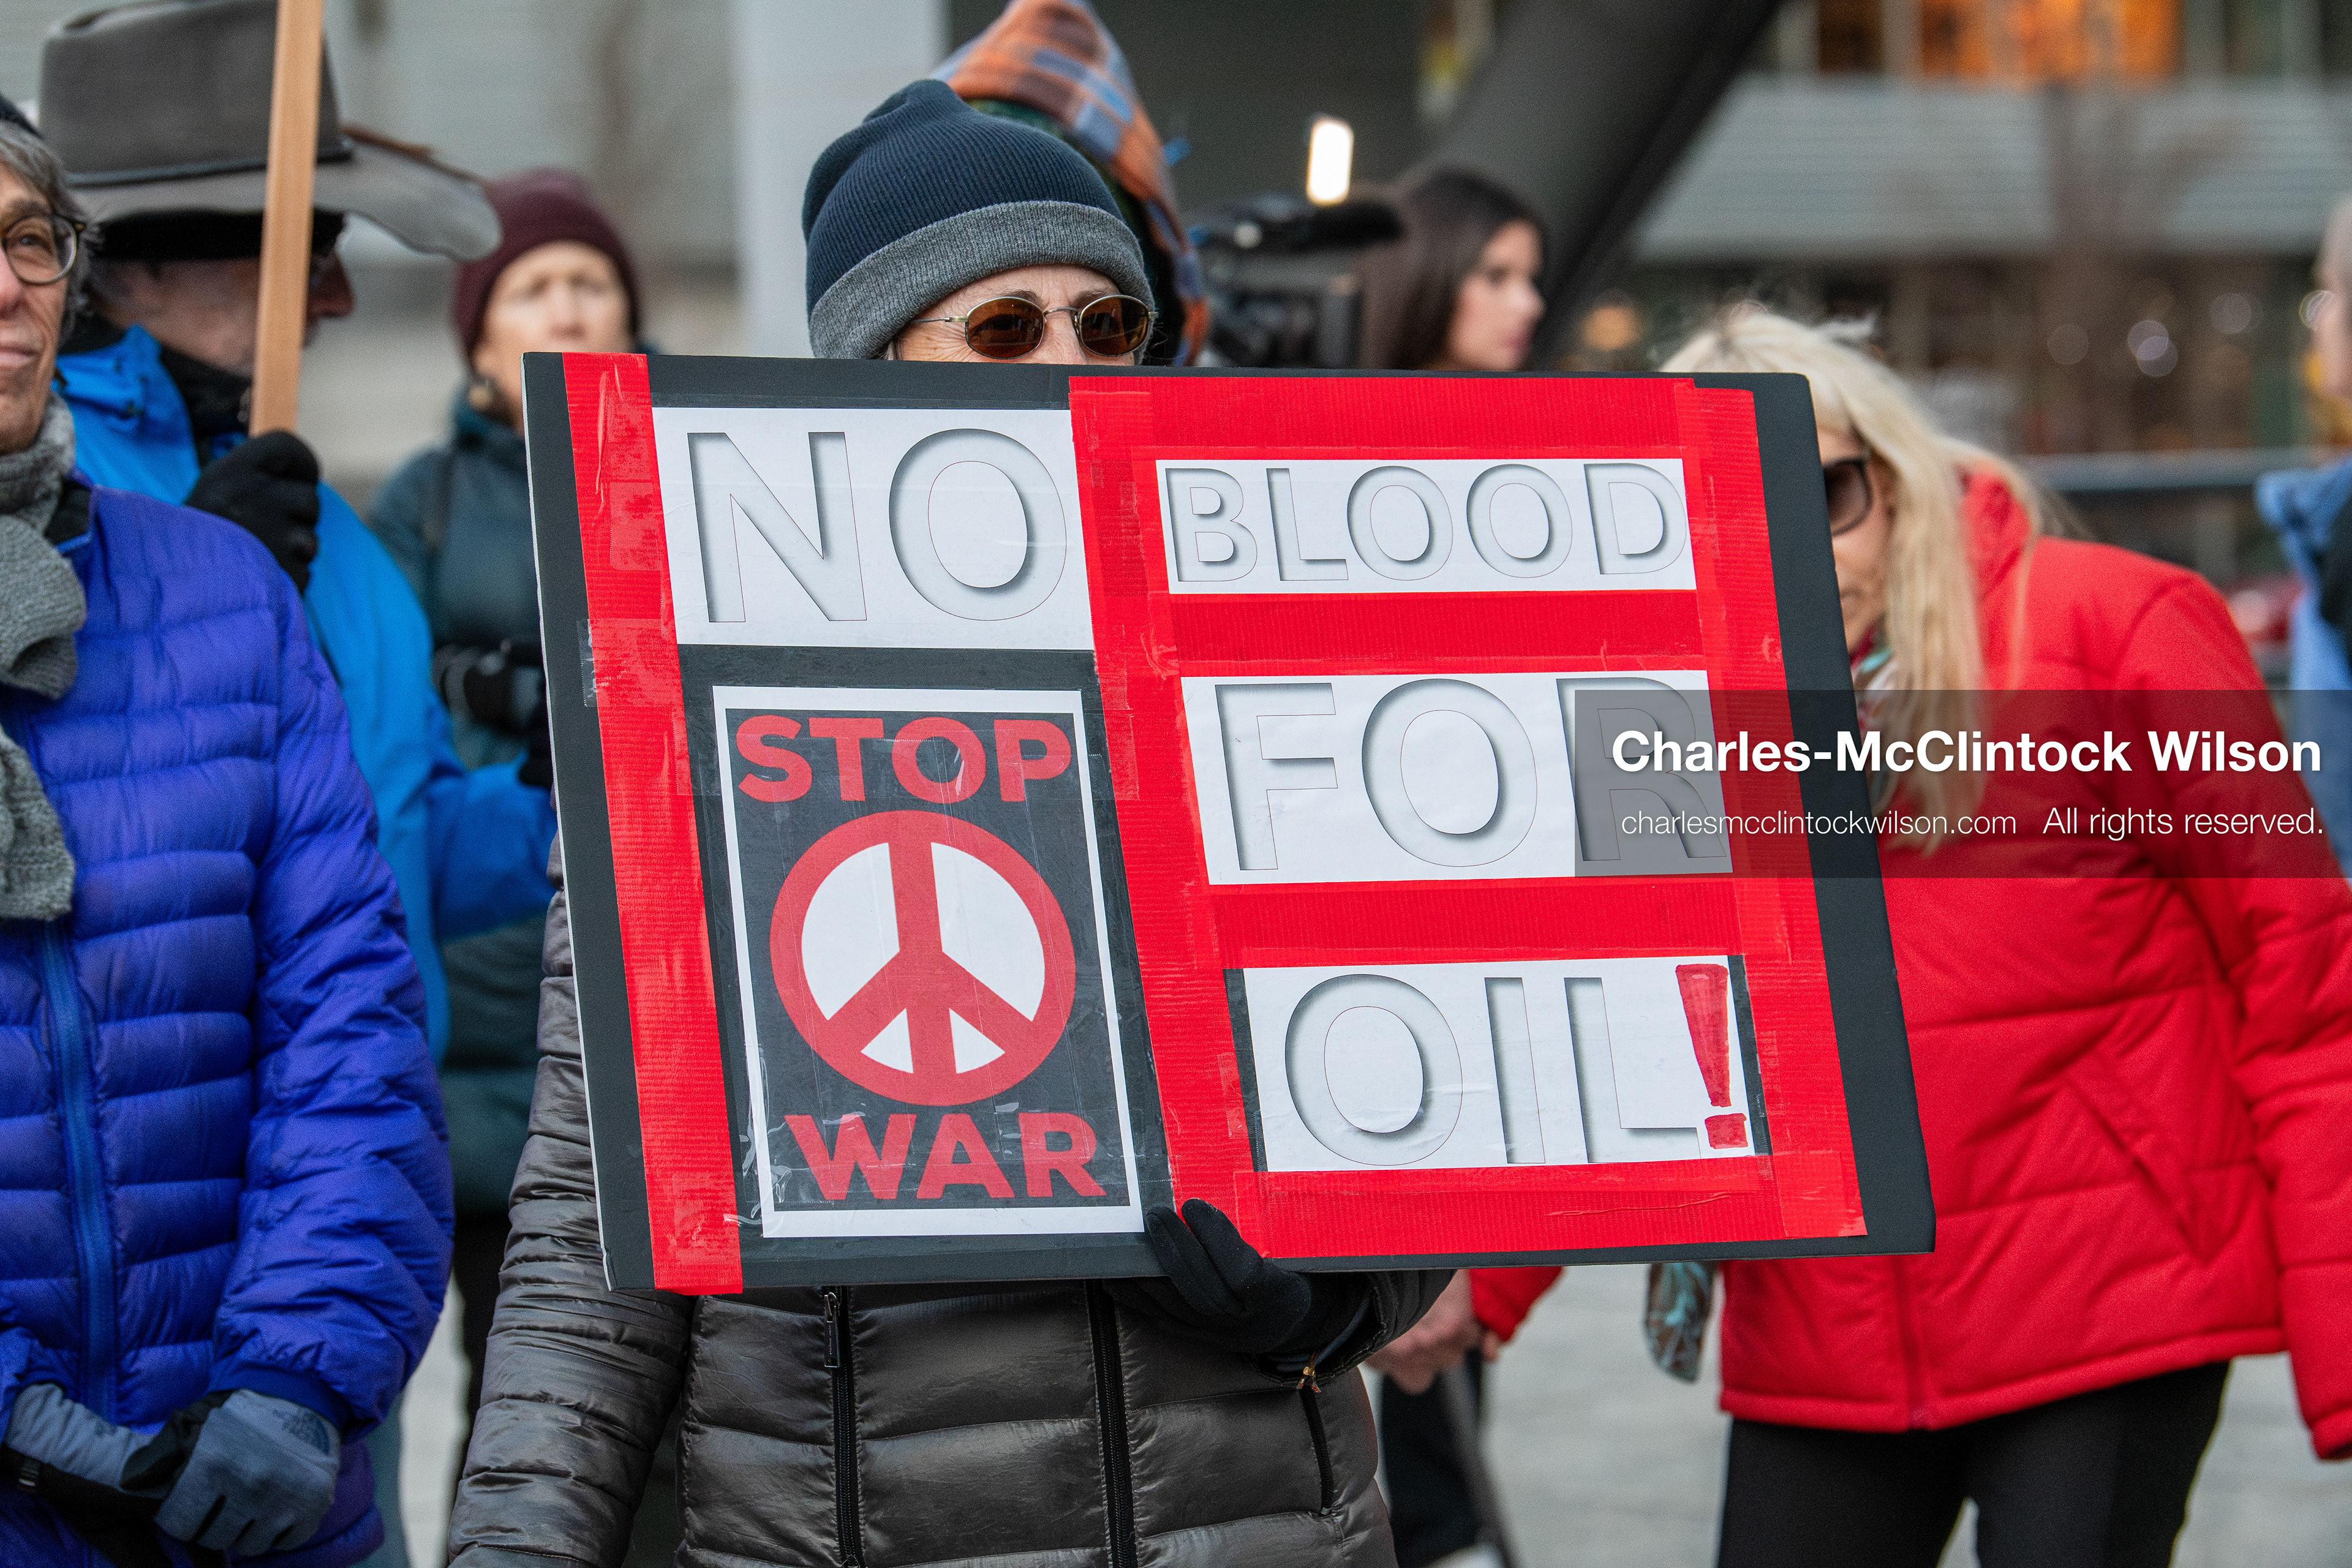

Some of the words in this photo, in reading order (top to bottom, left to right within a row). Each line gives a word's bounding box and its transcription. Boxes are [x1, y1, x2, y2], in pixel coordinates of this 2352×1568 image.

[687, 428, 1067, 623] NO
[1165, 462, 1687, 582] BLOOD
[736, 715, 1071, 804] STOP
[1215, 677, 1727, 871] FOR
[1284, 963, 1749, 1166] OIL!
[785, 1112, 1107, 1200] WAR
